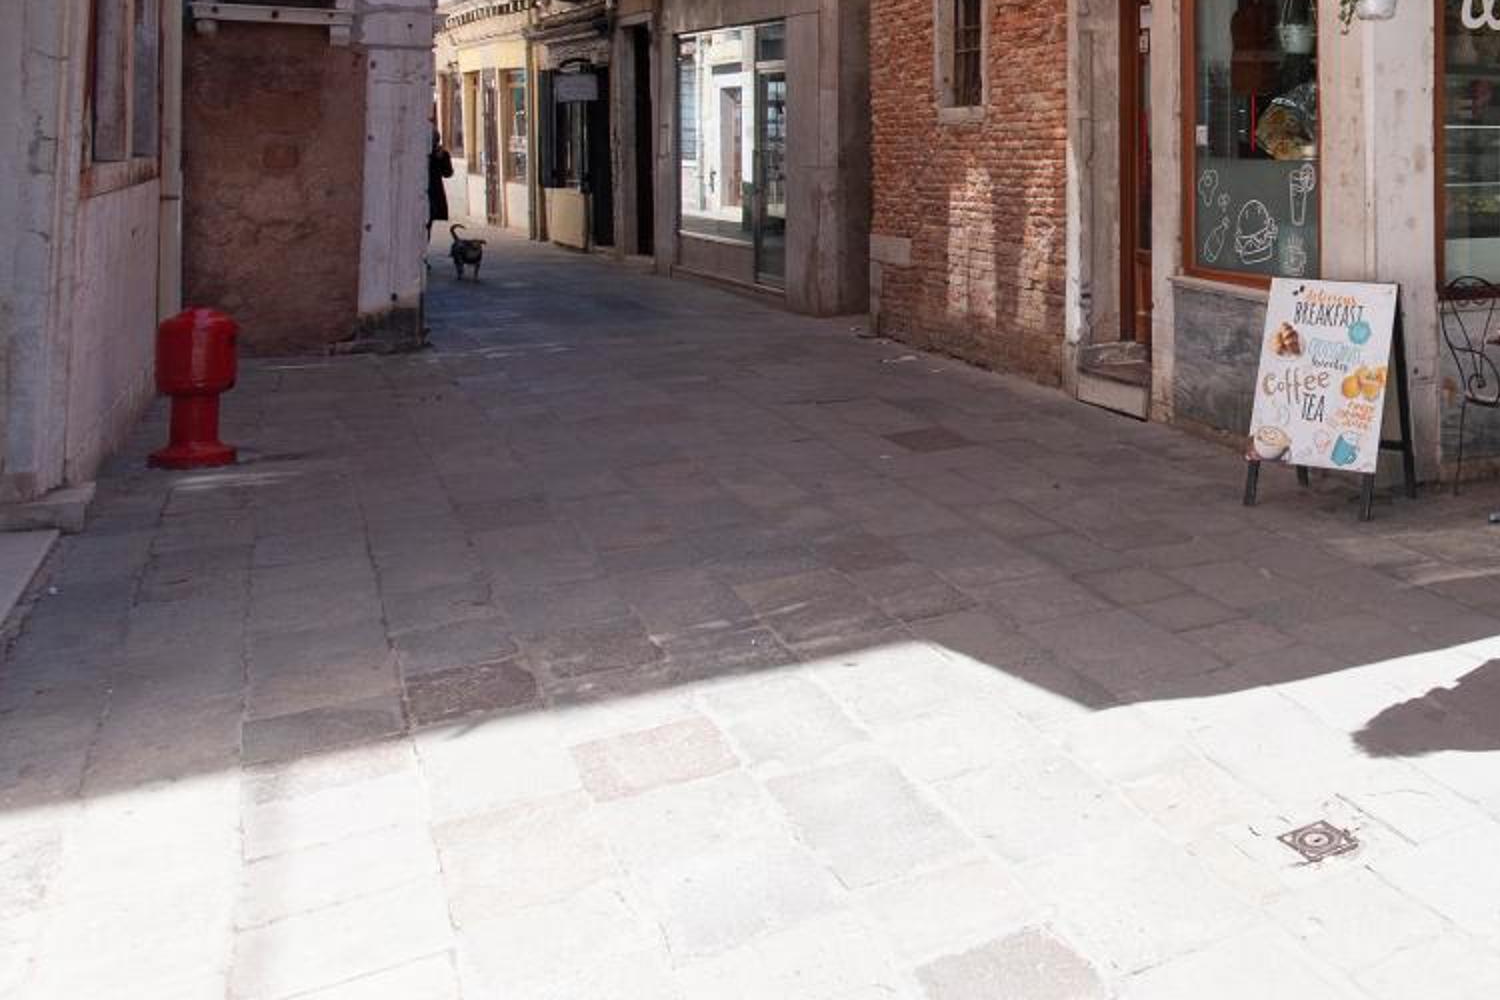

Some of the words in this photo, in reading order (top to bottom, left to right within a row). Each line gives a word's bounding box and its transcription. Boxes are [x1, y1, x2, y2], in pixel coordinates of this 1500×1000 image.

[1293, 301, 1366, 328] BREAKFAST
[1262, 367, 1330, 405] Coffee
[1301, 391, 1325, 423] TEA
